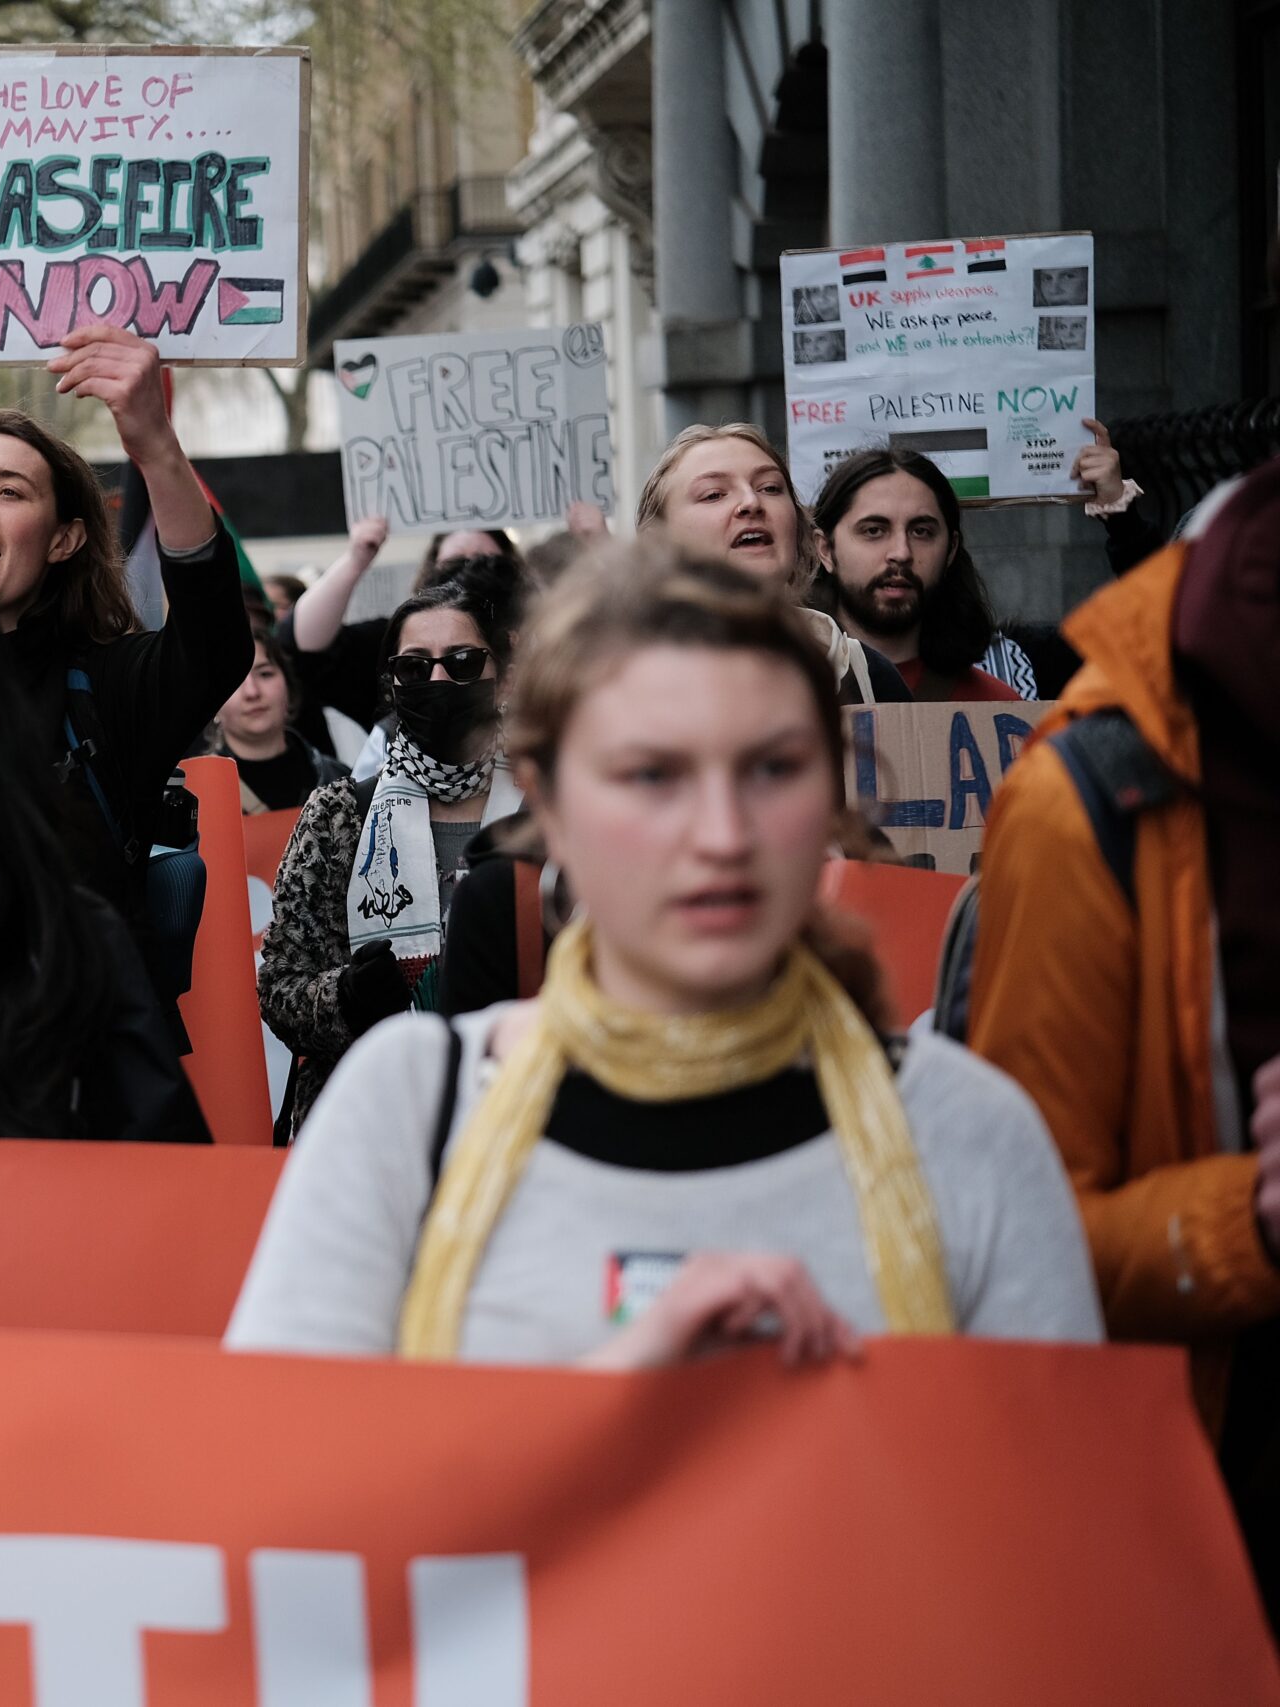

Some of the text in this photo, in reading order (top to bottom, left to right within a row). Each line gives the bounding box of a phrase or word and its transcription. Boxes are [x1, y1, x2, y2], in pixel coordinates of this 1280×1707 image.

[40, 74, 122, 109] LOVE
[141, 71, 195, 109] OF
[848, 288, 883, 309] UK
[890, 286, 932, 306] supply
[865, 310, 896, 331] WE
[900, 312, 927, 330] ask
[932, 314, 953, 330] for
[855, 340, 881, 354] and
[885, 333, 909, 354] WE
[913, 338, 932, 350] are
[938, 330, 960, 348] the
[385, 345, 561, 433] FREE
[791, 385, 1079, 424] FREE PALESTINE NOW
[1025, 437, 1057, 449] STOP
[344, 413, 615, 526] PALESTINE
